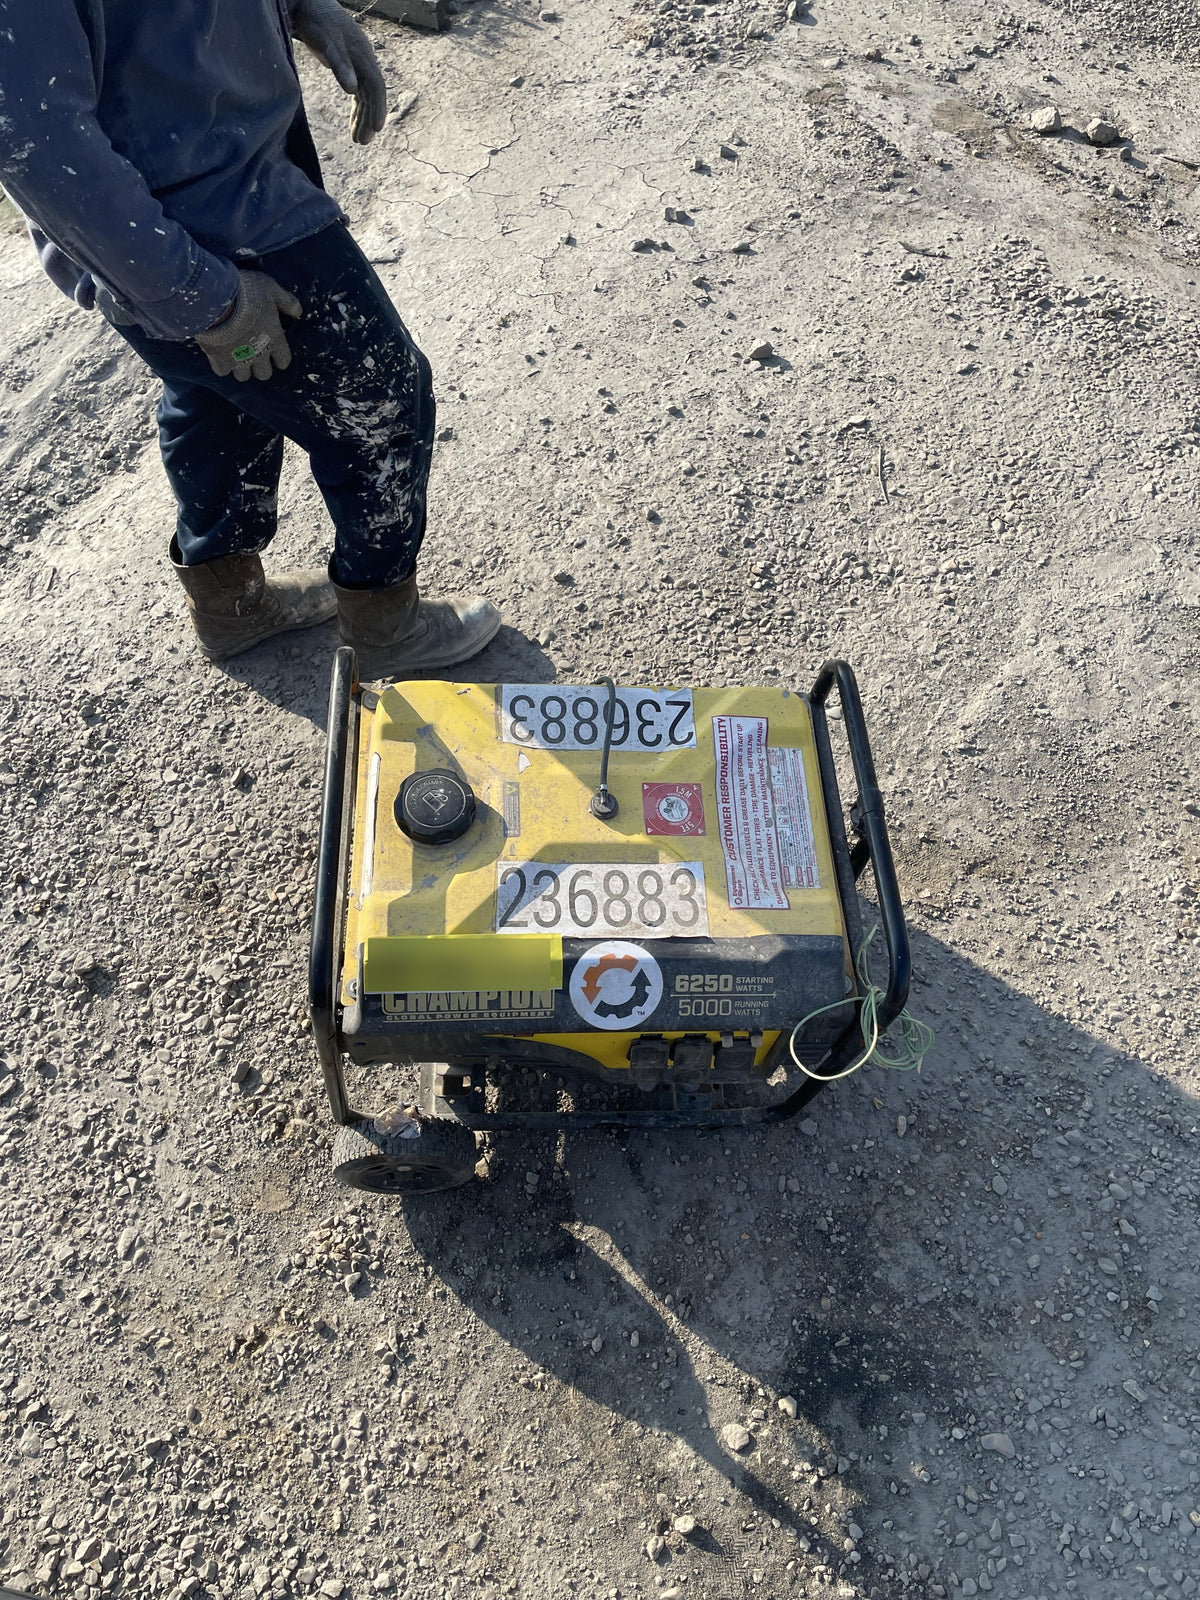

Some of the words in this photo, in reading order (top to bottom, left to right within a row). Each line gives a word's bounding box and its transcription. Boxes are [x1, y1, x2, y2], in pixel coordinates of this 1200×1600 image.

[509, 694, 694, 747] 236883
[718, 718, 729, 804] RESPONSIBILITY
[758, 758, 766, 800] MAINTENANCE
[724, 807, 737, 860] CUSTOMER
[768, 832, 776, 870] EQUIPMENT
[760, 857, 770, 891] INSURANCE
[771, 872, 777, 880] TO
[499, 867, 699, 928] 236883
[772, 882, 783, 904] DAMAGE
[675, 974, 733, 992] 6250
[735, 976, 774, 984] STARTING
[483, 1011, 552, 1019] EQUIPMENT
[678, 999, 732, 1016] 5000
[734, 1000, 769, 1008] RUNNING
